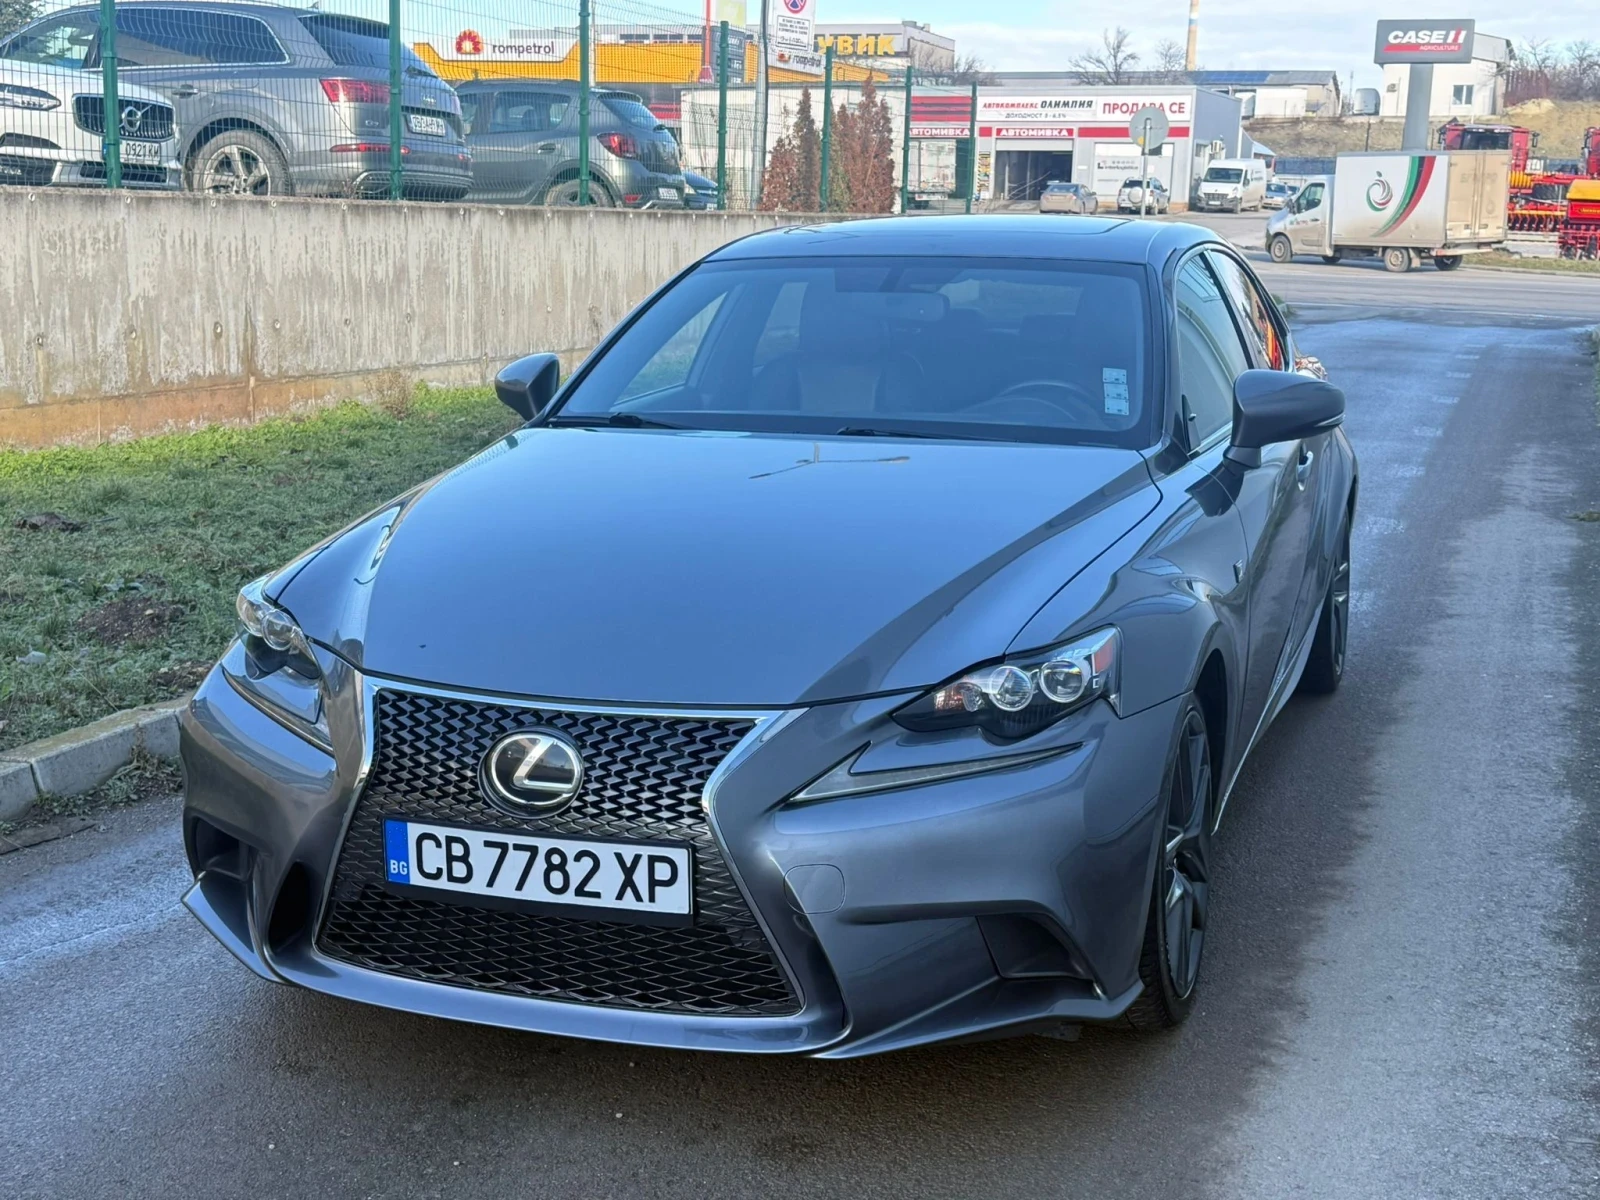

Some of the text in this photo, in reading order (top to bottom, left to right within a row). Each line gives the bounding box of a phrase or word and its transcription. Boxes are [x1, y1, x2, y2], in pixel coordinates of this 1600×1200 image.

[1387, 30, 1447, 44] CASE
[492, 41, 555, 58] rompetrol
[1040, 100, 1093, 109] ОЛИМПИЯ
[1169, 102, 1185, 114] СЕ
[910, 128, 970, 136] ВТОМИВКА
[389, 859, 408, 876] BG
[415, 832, 679, 903] CB 7782 XP
